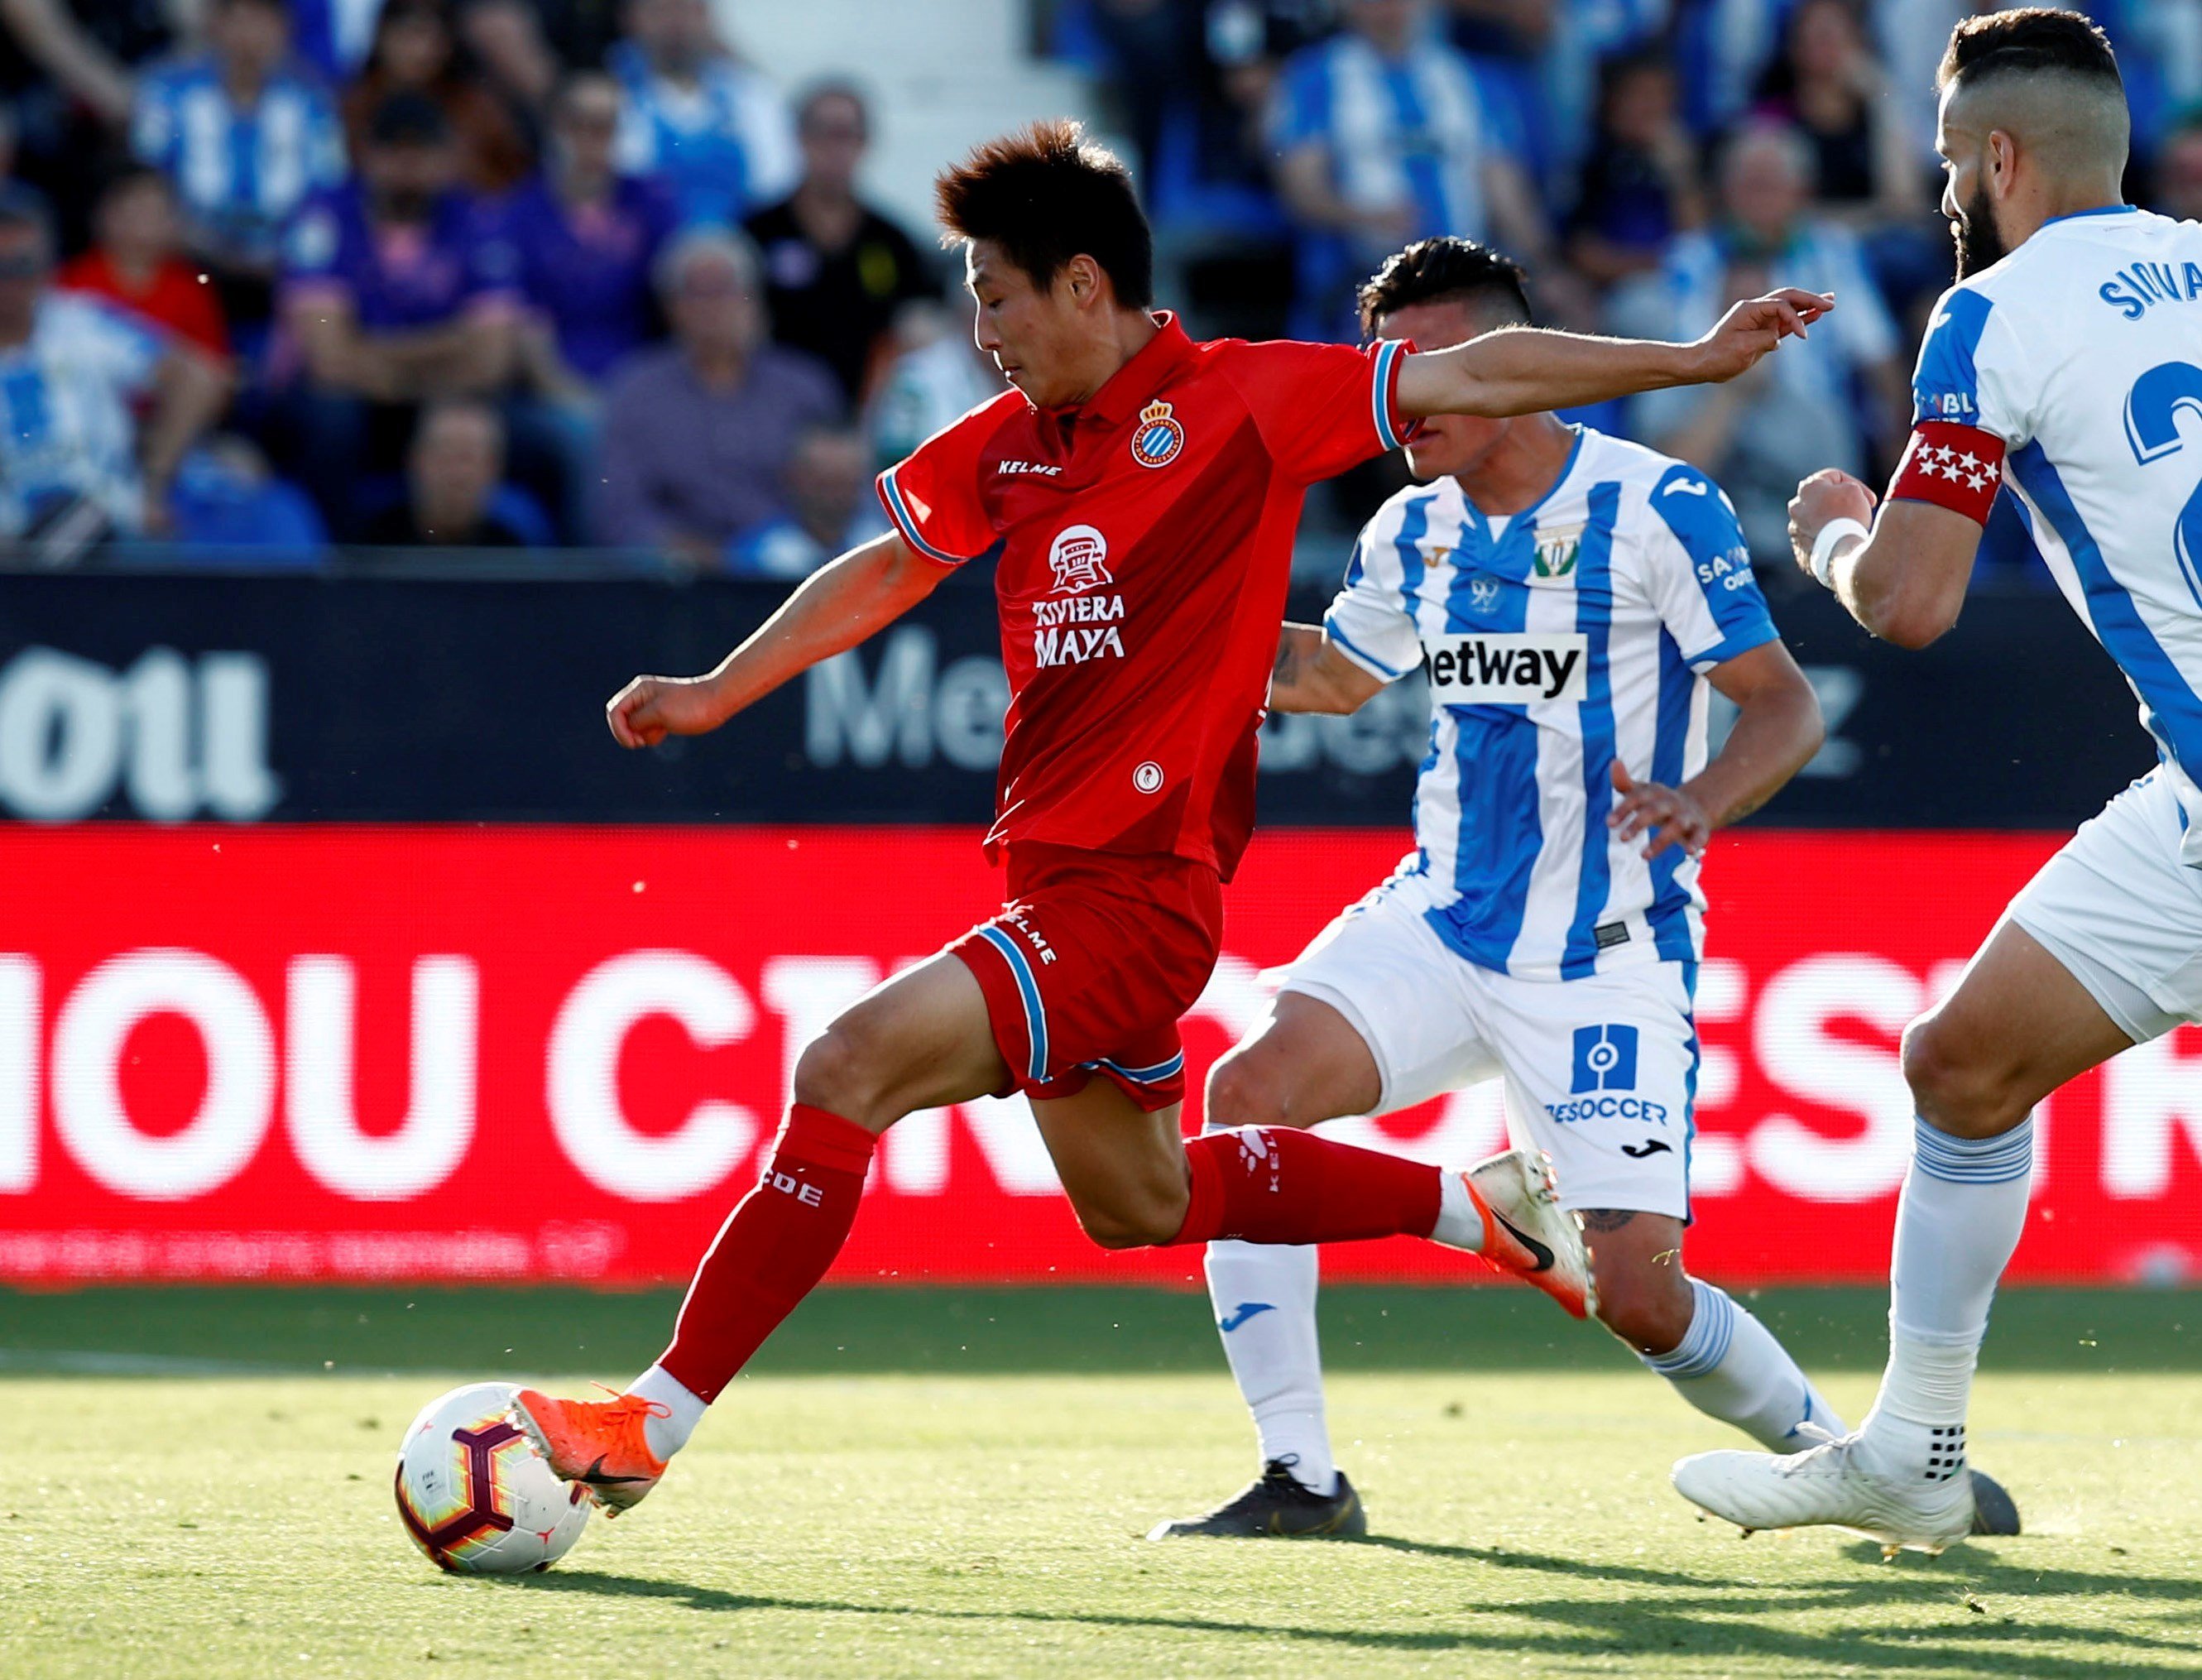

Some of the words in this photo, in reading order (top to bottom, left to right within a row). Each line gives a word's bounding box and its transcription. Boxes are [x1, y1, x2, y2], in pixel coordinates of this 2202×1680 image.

[998, 460, 1063, 476] KELME
[1032, 595, 1125, 626] RIVIERA
[1034, 626, 1125, 669] MAYA
[0, 947, 480, 1202] OU
